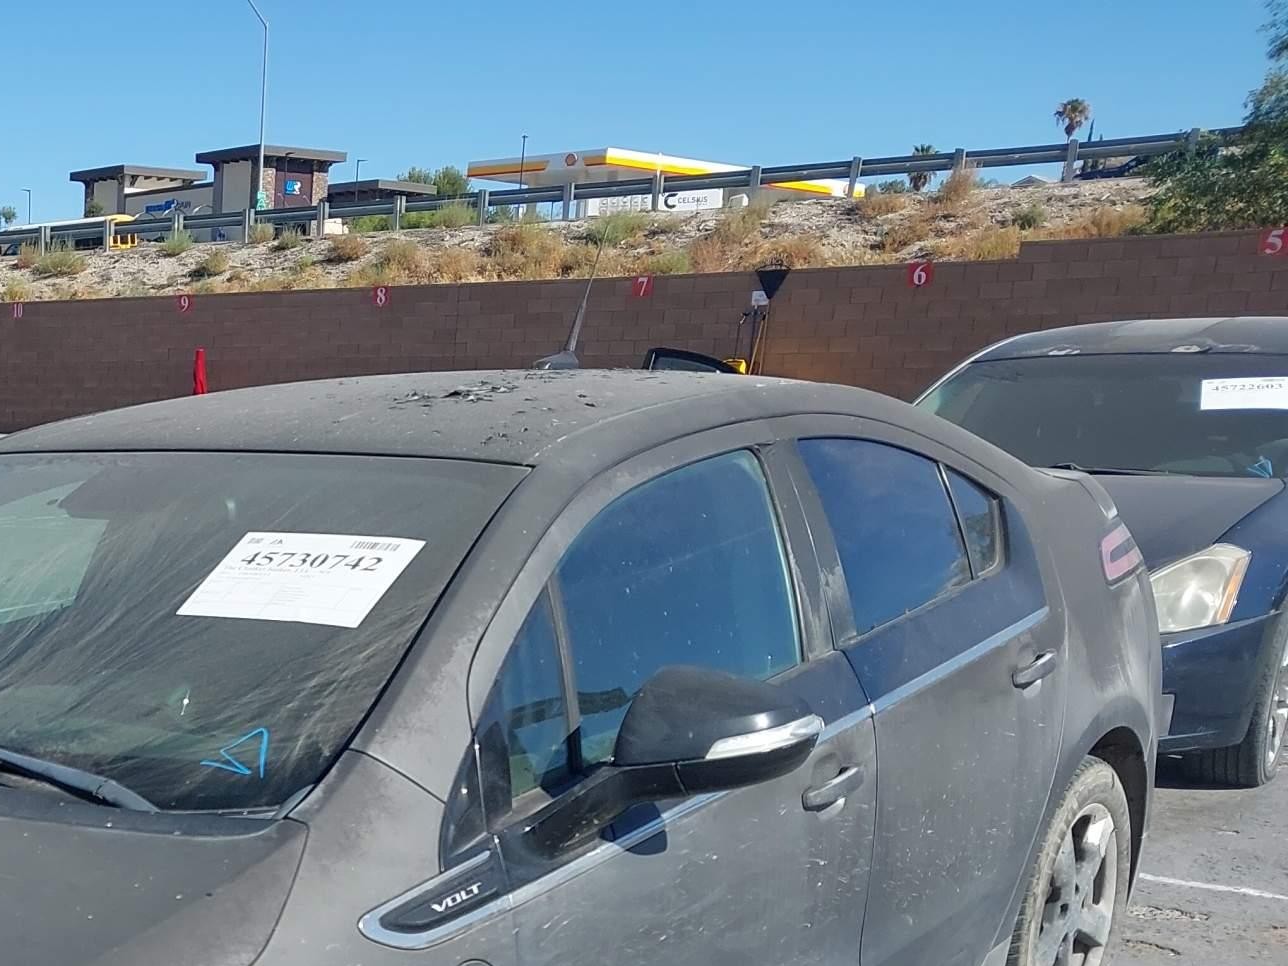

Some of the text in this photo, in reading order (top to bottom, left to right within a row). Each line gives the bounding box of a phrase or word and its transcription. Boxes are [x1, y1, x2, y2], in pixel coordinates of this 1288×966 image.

[1265, 230, 1283, 254] 5
[913, 263, 928, 285] 6
[376, 287, 386, 306] 8
[637, 277, 649, 296] 7
[13, 303, 23, 317] 10
[180, 296, 189, 312] 9
[241, 551, 384, 572] 45730742
[431, 882, 482, 912] VOLT
